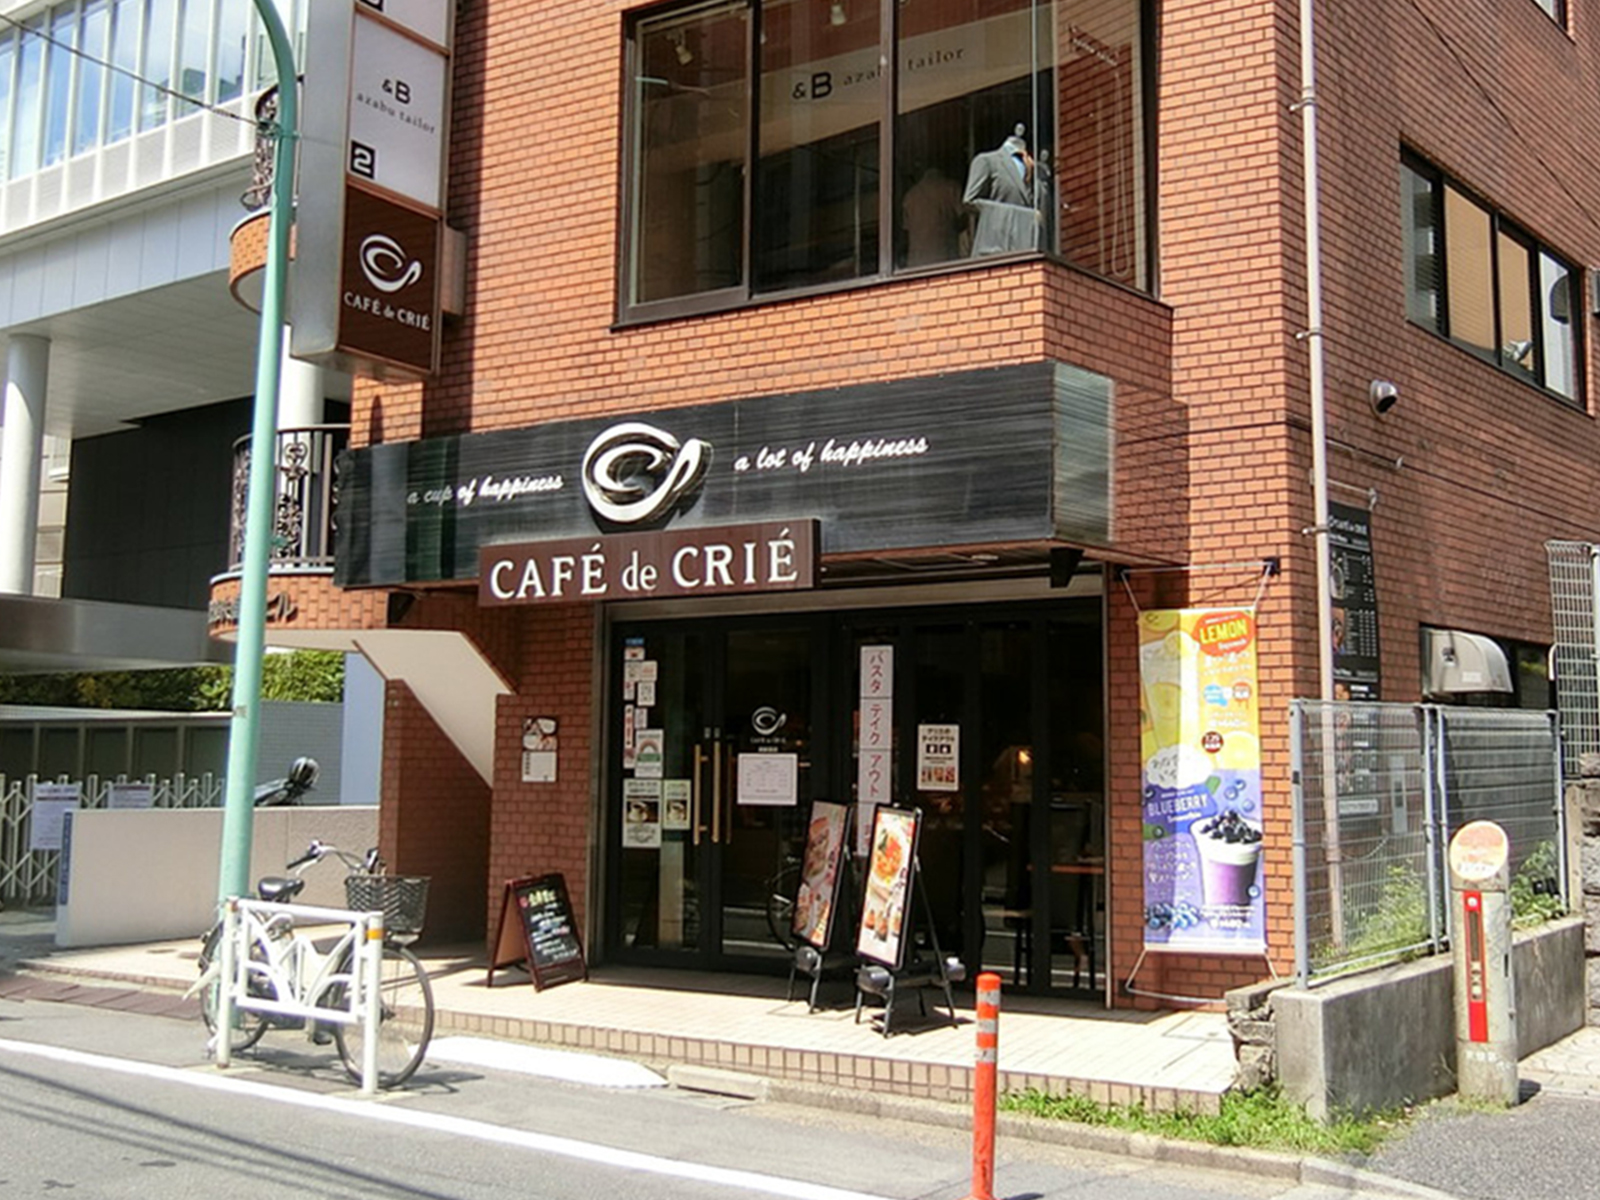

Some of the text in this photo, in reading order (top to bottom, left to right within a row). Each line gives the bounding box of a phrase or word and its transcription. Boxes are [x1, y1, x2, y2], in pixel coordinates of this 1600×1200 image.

[791, 71, 833, 99] &B
[907, 49, 965, 72] tailor
[382, 78, 411, 105] &B
[356, 92, 436, 135] azabu tailor
[353, 147, 373, 174] 2
[343, 291, 381, 316] CAFÉ
[397, 308, 431, 332] CRIÉ
[734, 437, 930, 473] a lot of happiness
[406, 474, 565, 507] a cup of happiness
[489, 527, 798, 600] CAFÉ de CRIÉ
[1199, 618, 1248, 645] LEMON
[1147, 793, 1209, 818] BLUEBERRY
